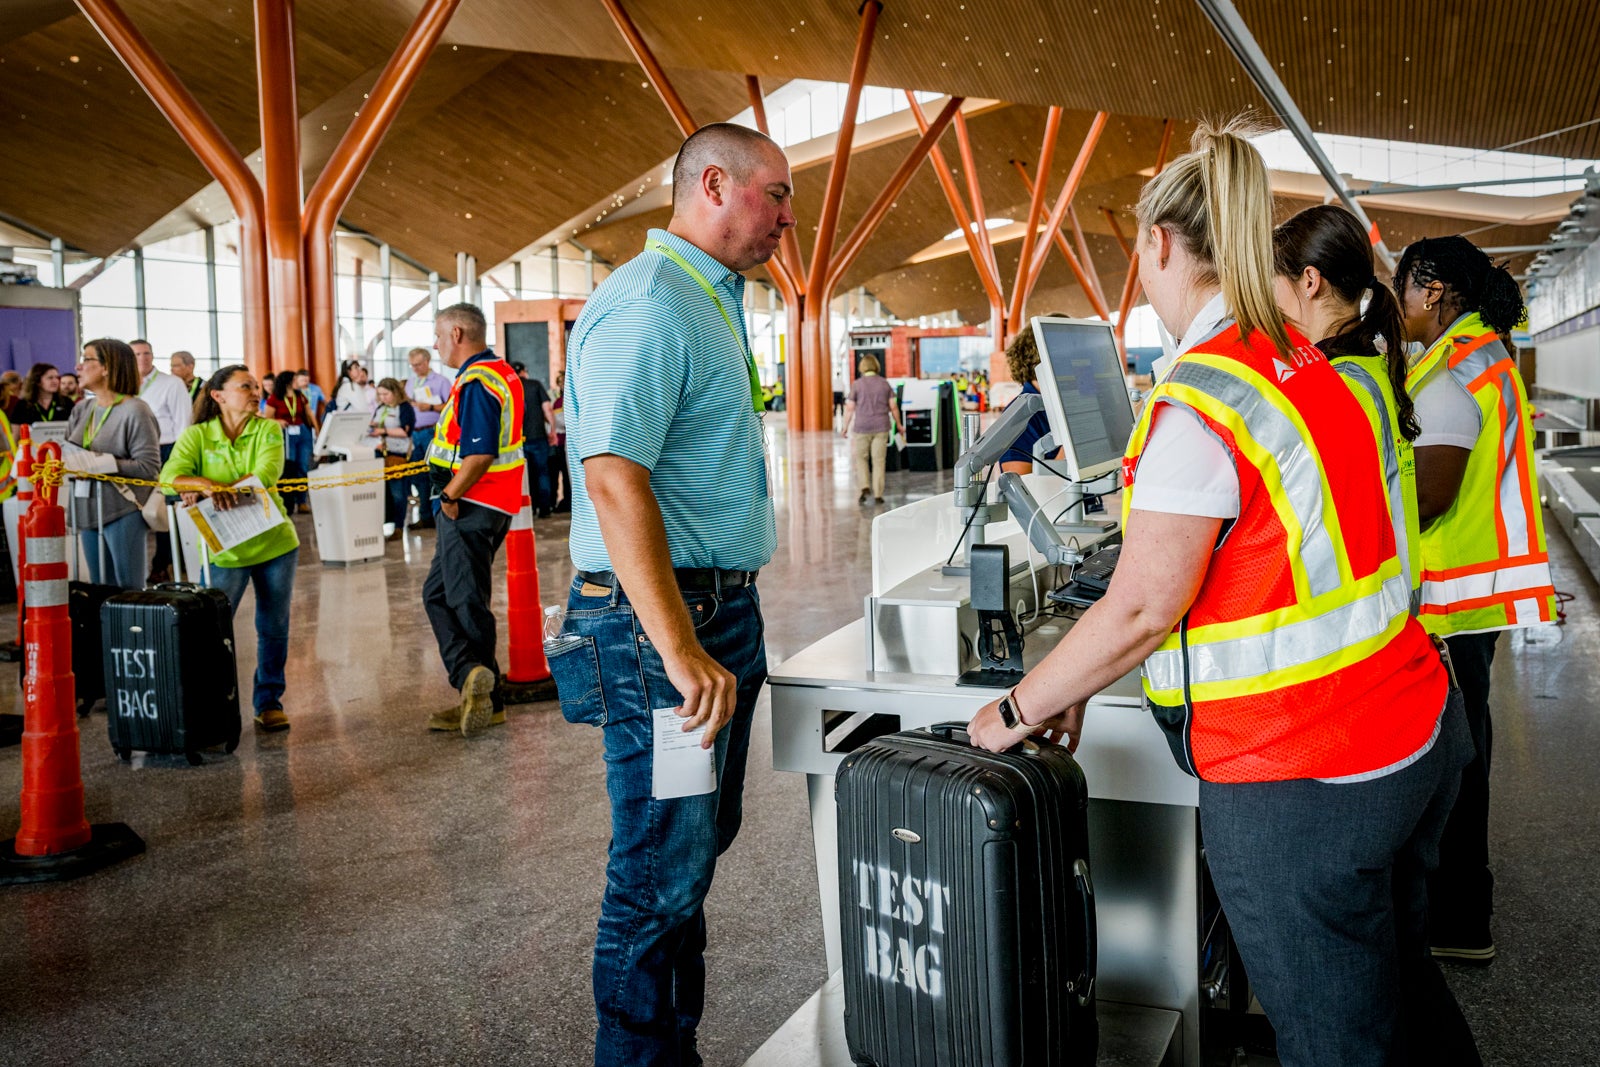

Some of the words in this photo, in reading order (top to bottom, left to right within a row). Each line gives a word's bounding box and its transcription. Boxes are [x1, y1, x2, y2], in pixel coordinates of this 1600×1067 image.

[1288, 344, 1328, 368] DELT
[110, 647, 157, 679] TEST
[117, 688, 158, 720] BAG
[852, 858, 950, 935] TEST
[865, 924, 942, 997] BAG
